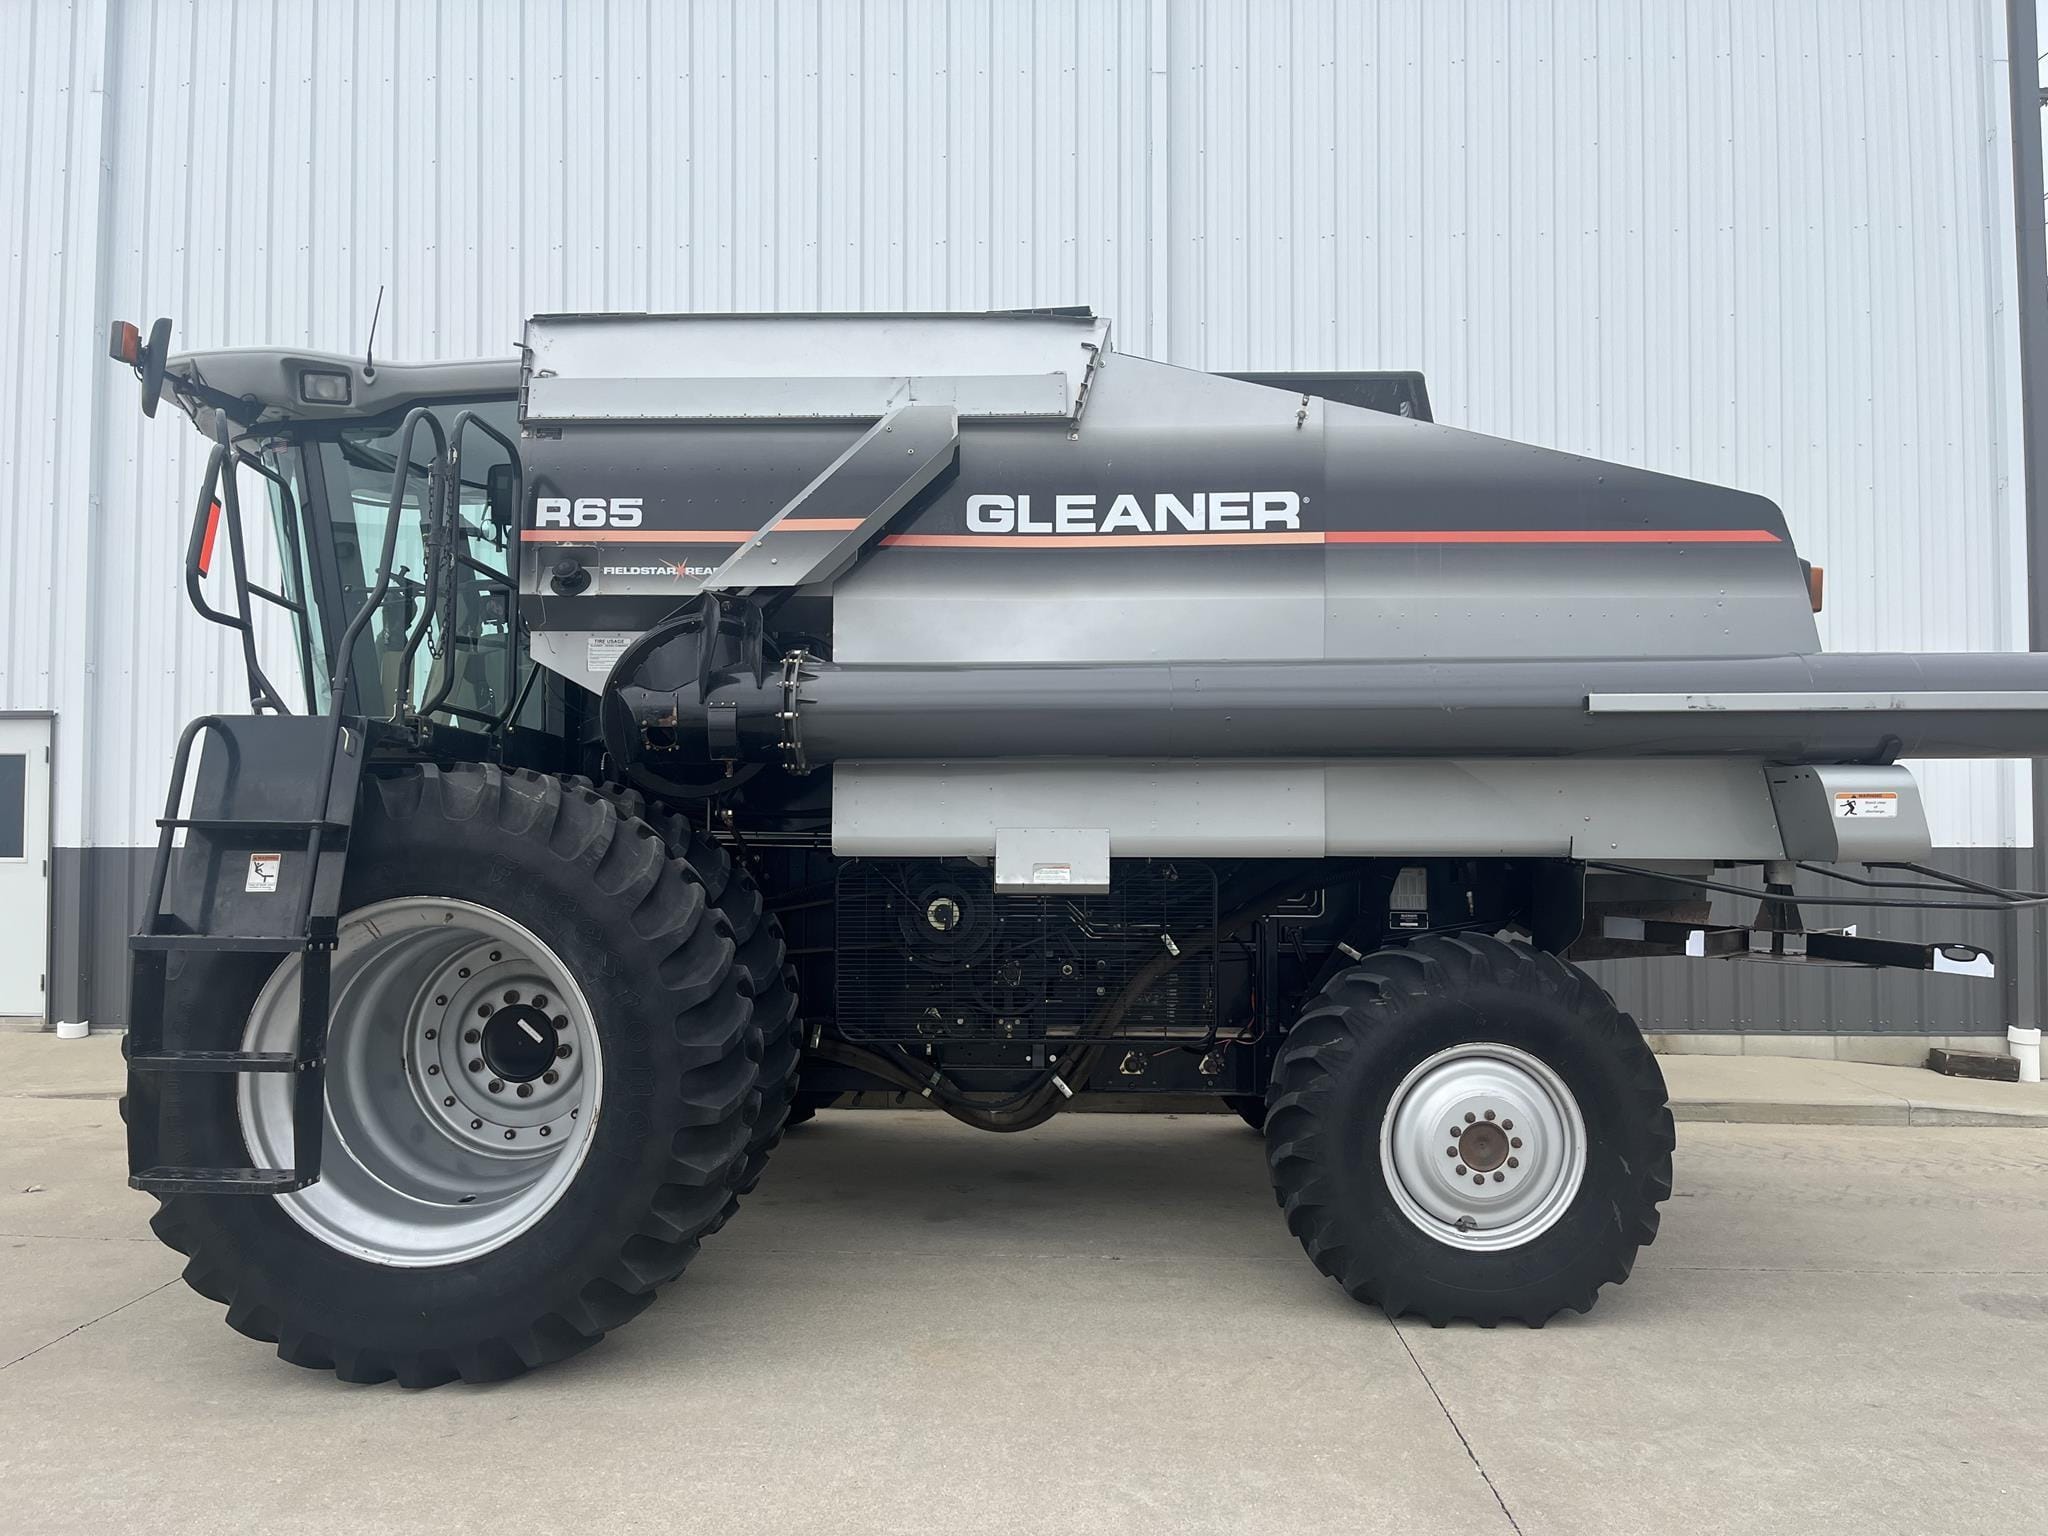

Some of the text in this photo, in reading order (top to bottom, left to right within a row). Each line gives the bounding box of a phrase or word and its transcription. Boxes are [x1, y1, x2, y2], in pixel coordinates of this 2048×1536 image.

[535, 497, 643, 527] R65
[966, 491, 1300, 533] GLEANER
[603, 566, 677, 575] FIELDSTAR
